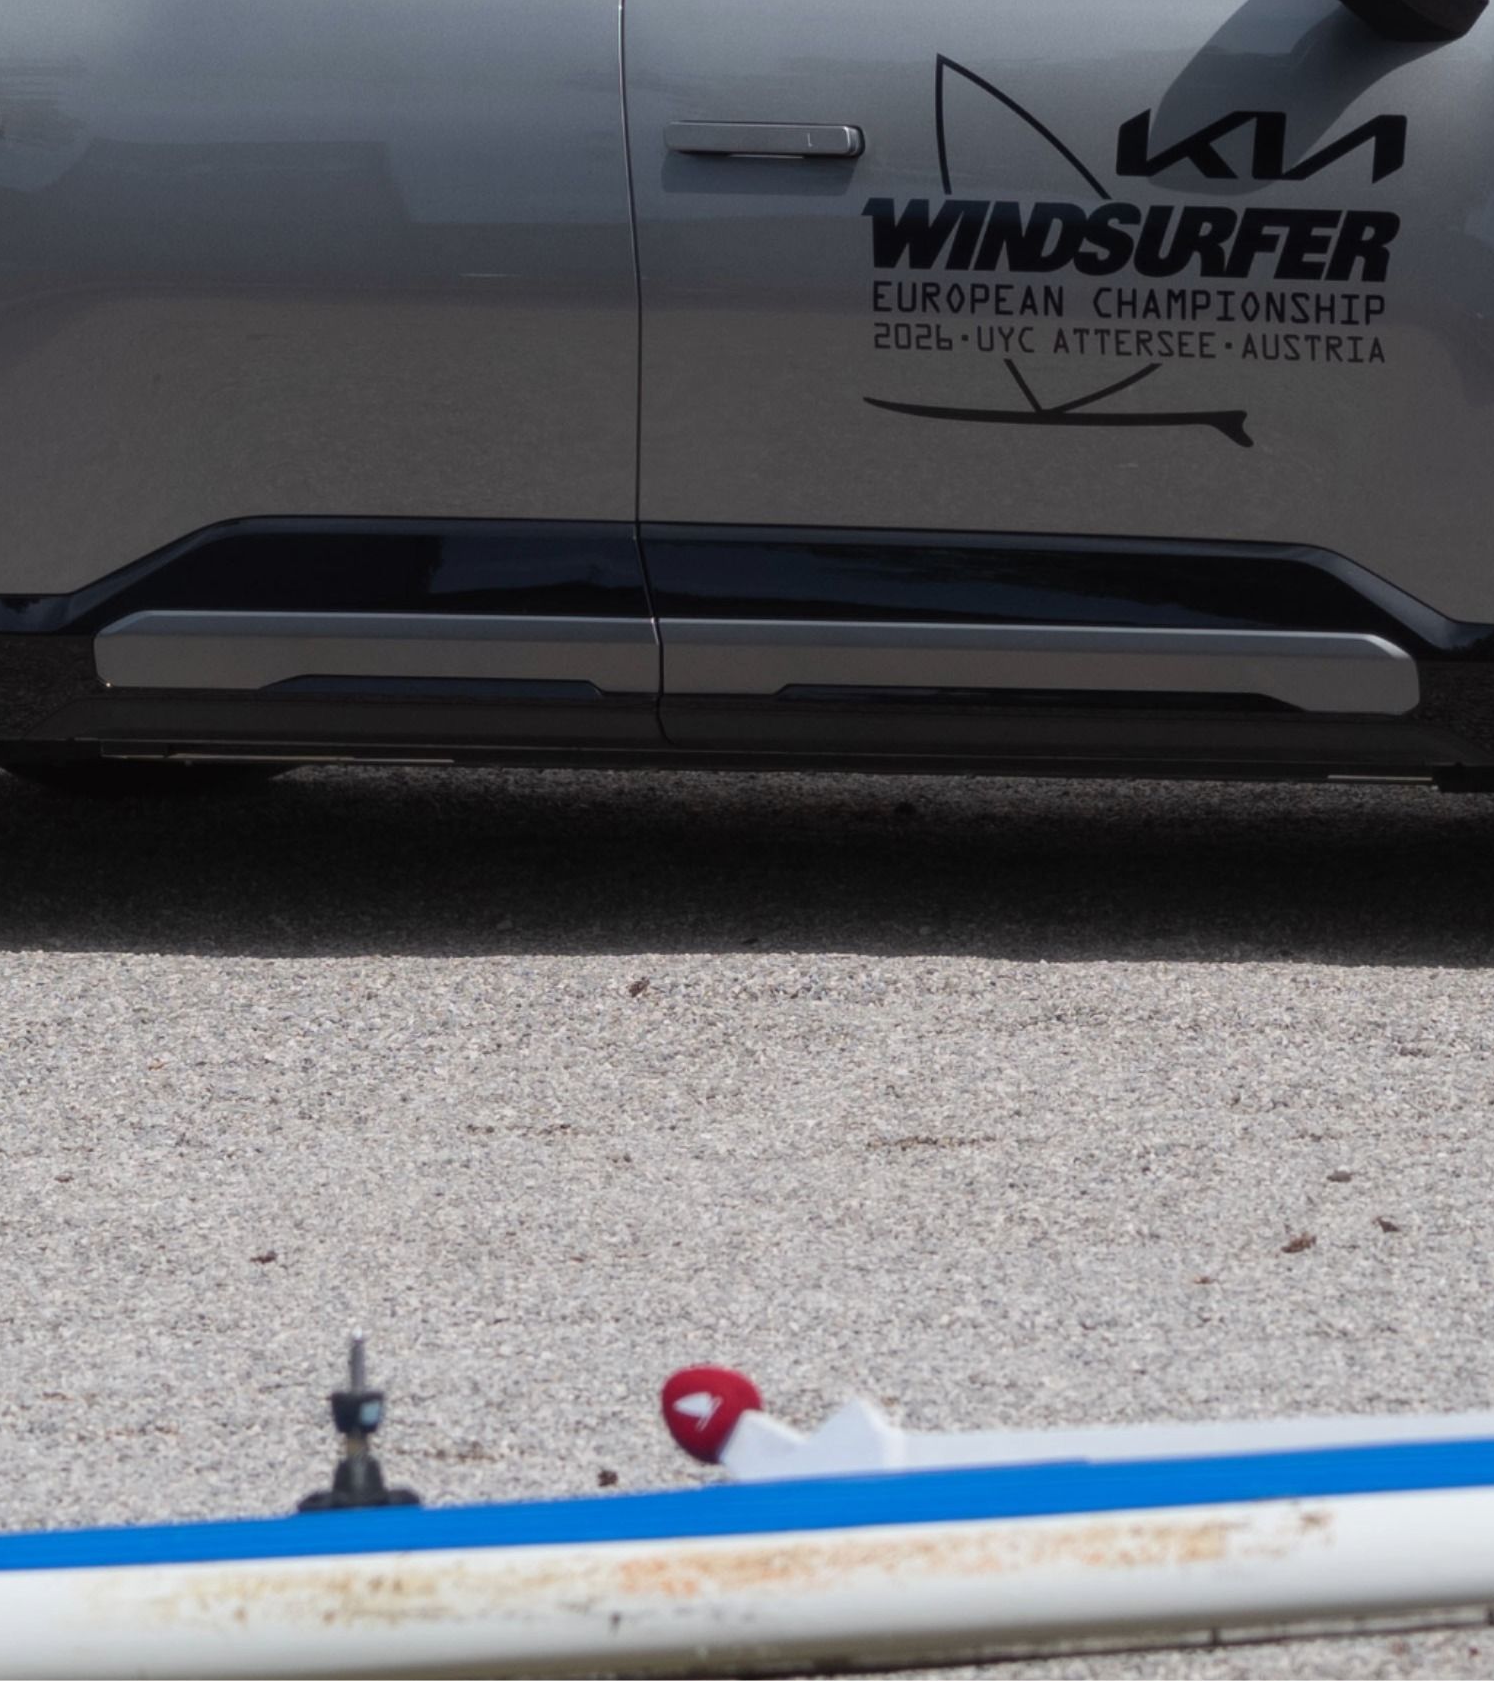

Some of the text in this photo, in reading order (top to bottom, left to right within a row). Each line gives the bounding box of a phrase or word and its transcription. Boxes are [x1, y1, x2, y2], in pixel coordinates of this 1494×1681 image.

[1116, 108, 1407, 183] KIA
[862, 197, 1400, 282] WINDSURFER
[873, 281, 1385, 325] EUROPEAN CHAMPIONSHIP
